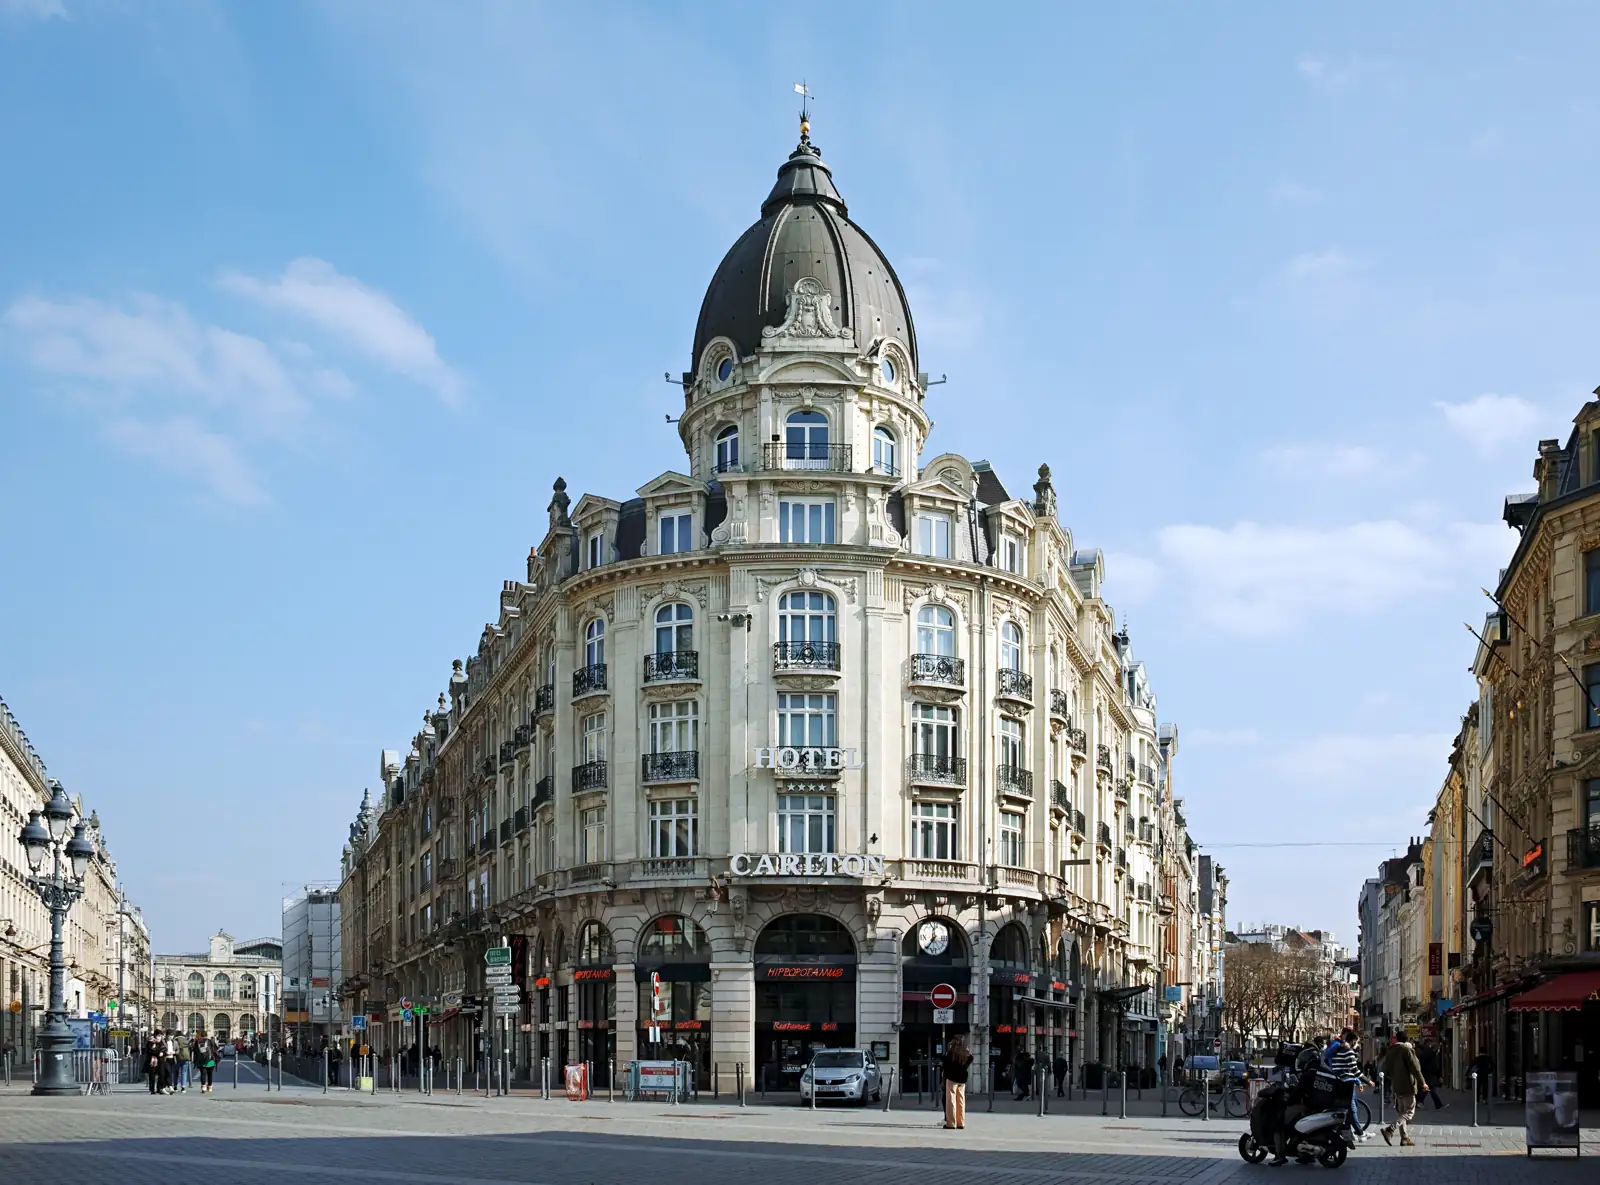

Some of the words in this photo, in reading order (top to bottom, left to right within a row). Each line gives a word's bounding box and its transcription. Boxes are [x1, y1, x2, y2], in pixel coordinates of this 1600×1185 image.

[753, 747, 864, 769] HOTEL
[730, 853, 886, 876] CARLTON
[767, 967, 843, 977] HIPPOPOTAMUS
